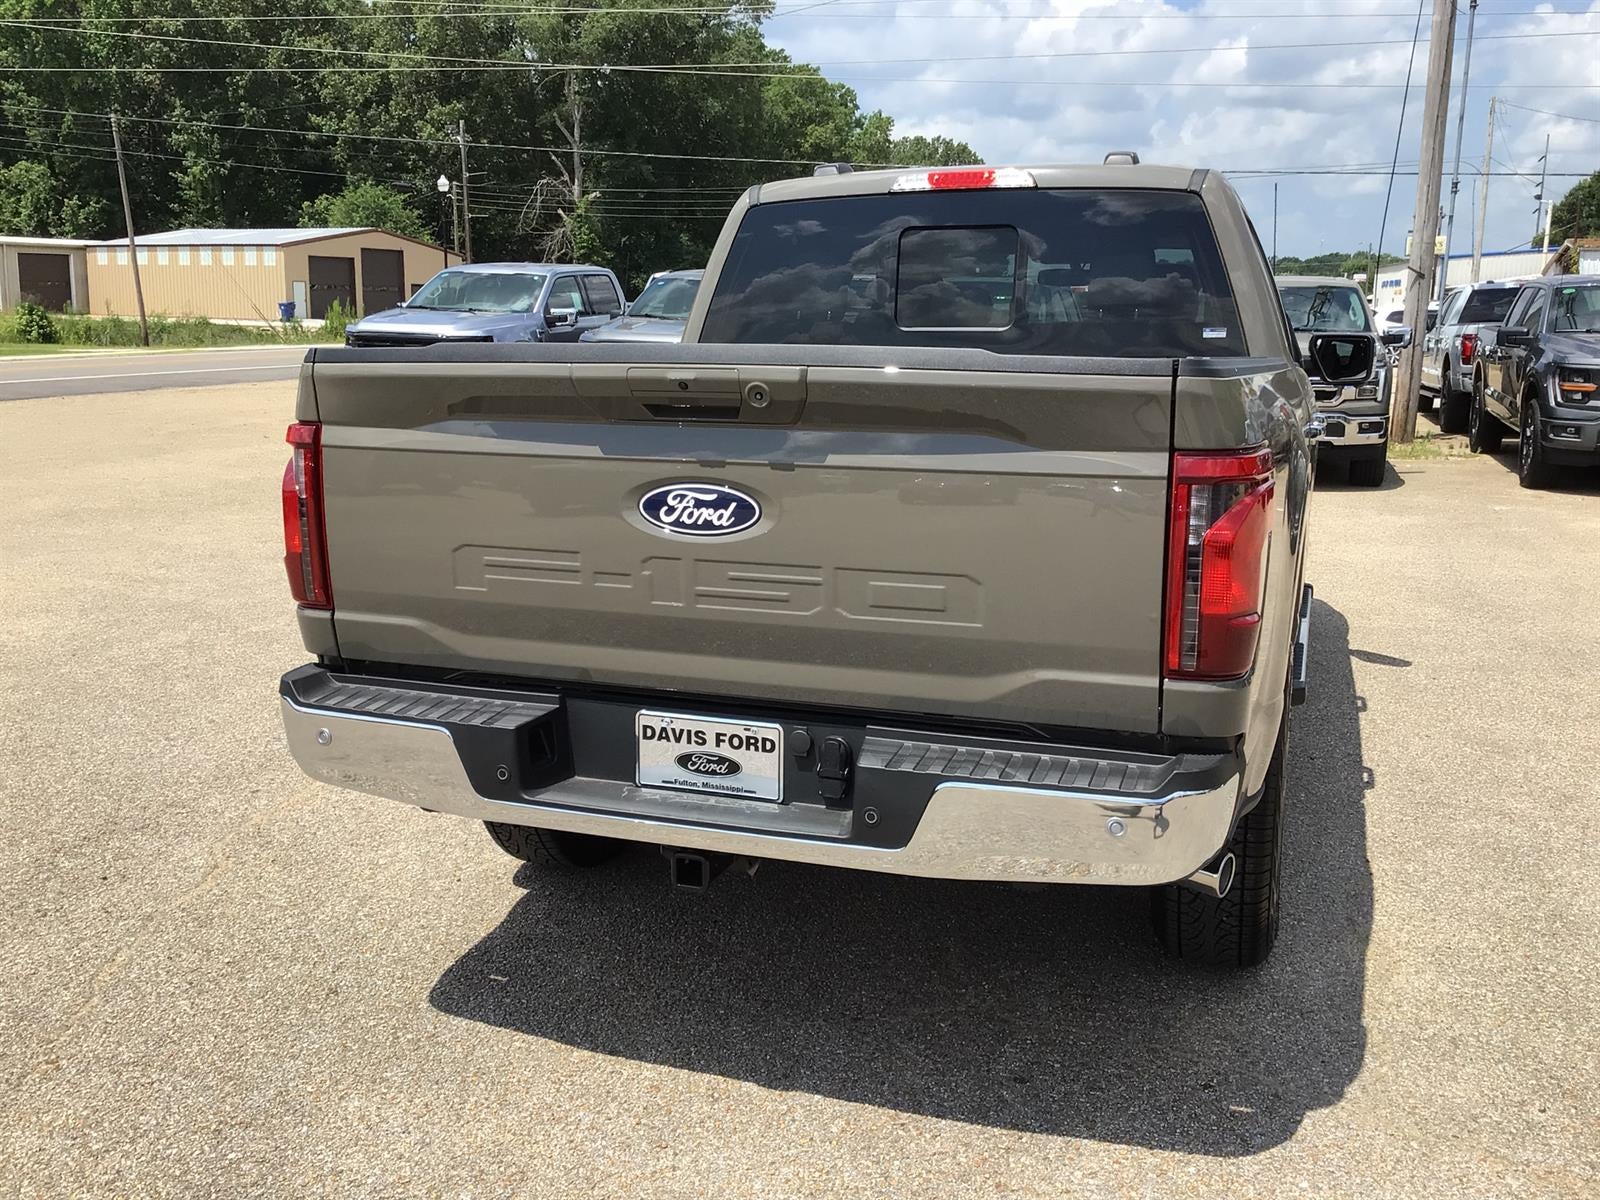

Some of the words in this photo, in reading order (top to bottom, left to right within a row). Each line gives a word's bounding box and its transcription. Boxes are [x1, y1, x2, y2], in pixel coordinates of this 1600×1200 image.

[659, 490, 738, 527] Ford
[452, 543, 984, 627] F-150
[642, 724, 707, 746] DAVIS
[715, 732, 776, 753] FORD
[687, 754, 729, 775] Ford
[674, 778, 700, 788] Fulton,
[701, 781, 744, 793] Mississippi
